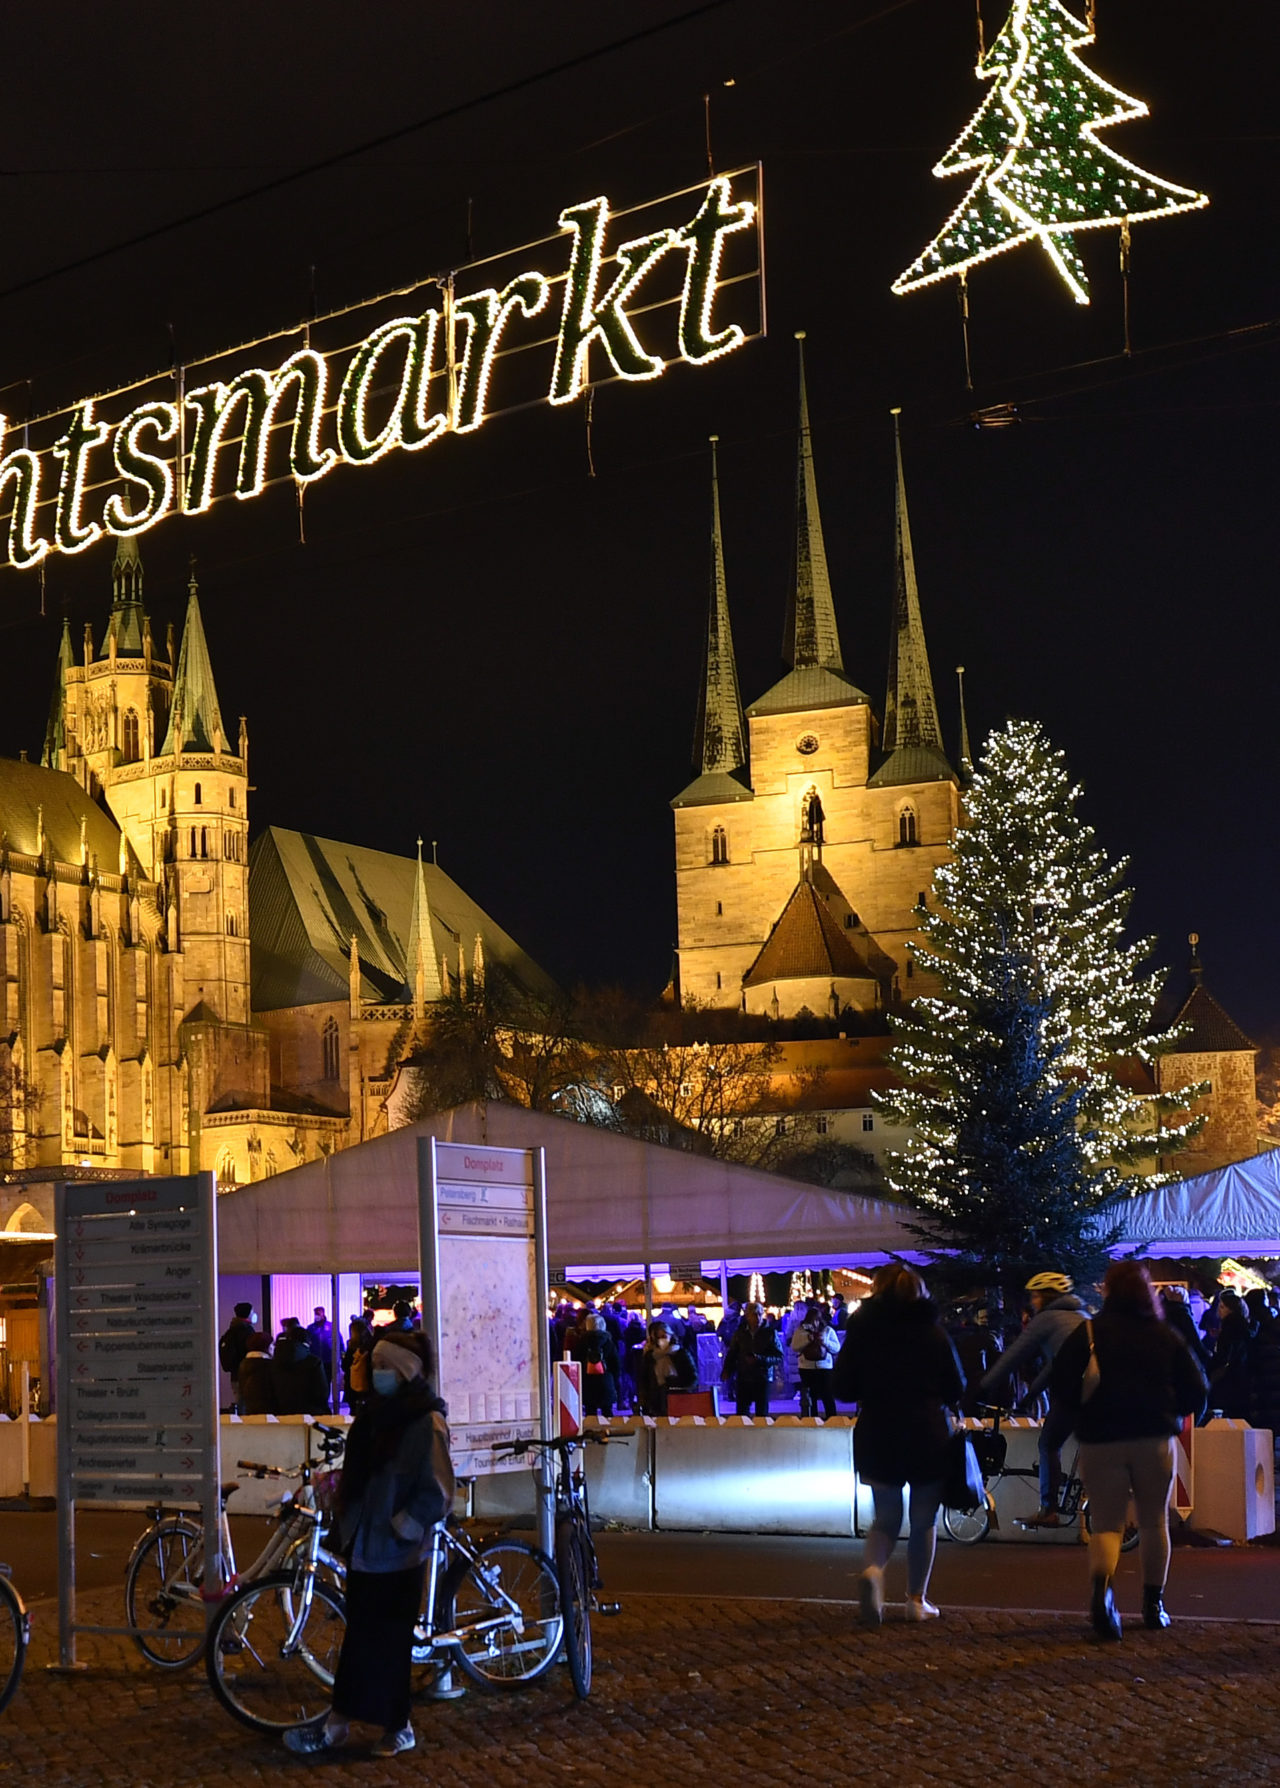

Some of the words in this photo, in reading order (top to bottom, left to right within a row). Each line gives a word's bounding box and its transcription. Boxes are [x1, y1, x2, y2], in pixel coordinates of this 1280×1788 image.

[463, 1155, 504, 1173] Domplatz
[105, 1189, 158, 1205] Domplatz
[165, 1267, 191, 1279] Anger
